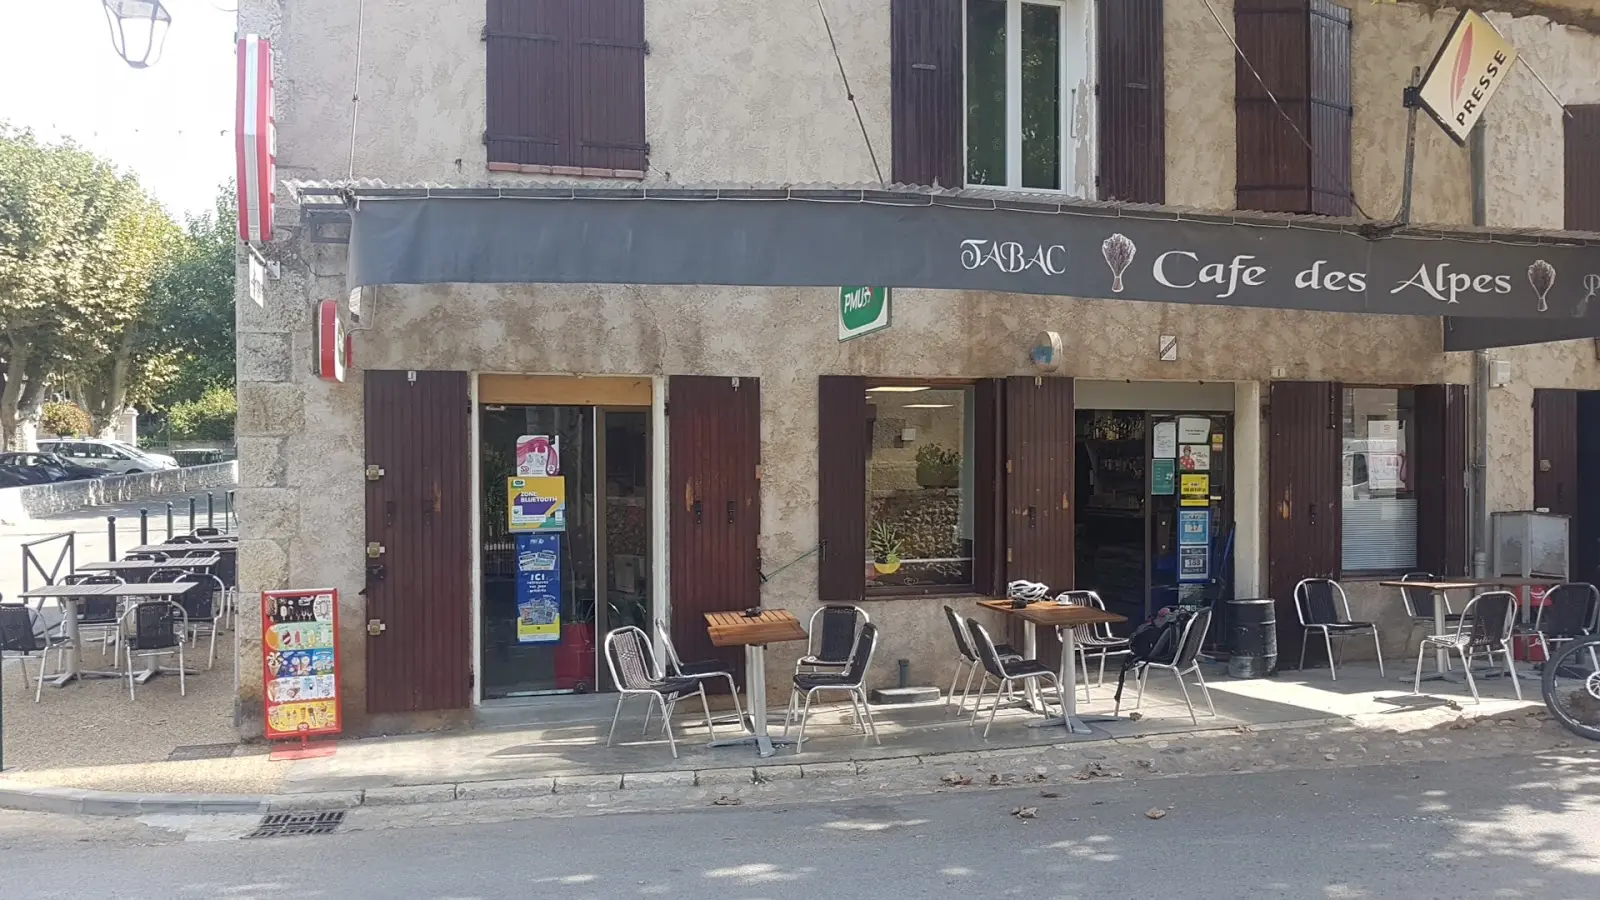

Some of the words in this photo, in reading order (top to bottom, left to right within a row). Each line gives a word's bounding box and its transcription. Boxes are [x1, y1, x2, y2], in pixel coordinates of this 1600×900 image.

[1456, 50, 1507, 126] PRESSE
[959, 238, 1067, 276] TABAC
[1152, 250, 1267, 298] Cafe
[1294, 260, 1367, 292] des
[1389, 263, 1512, 305] Alpes
[530, 573, 545, 581] ICI
